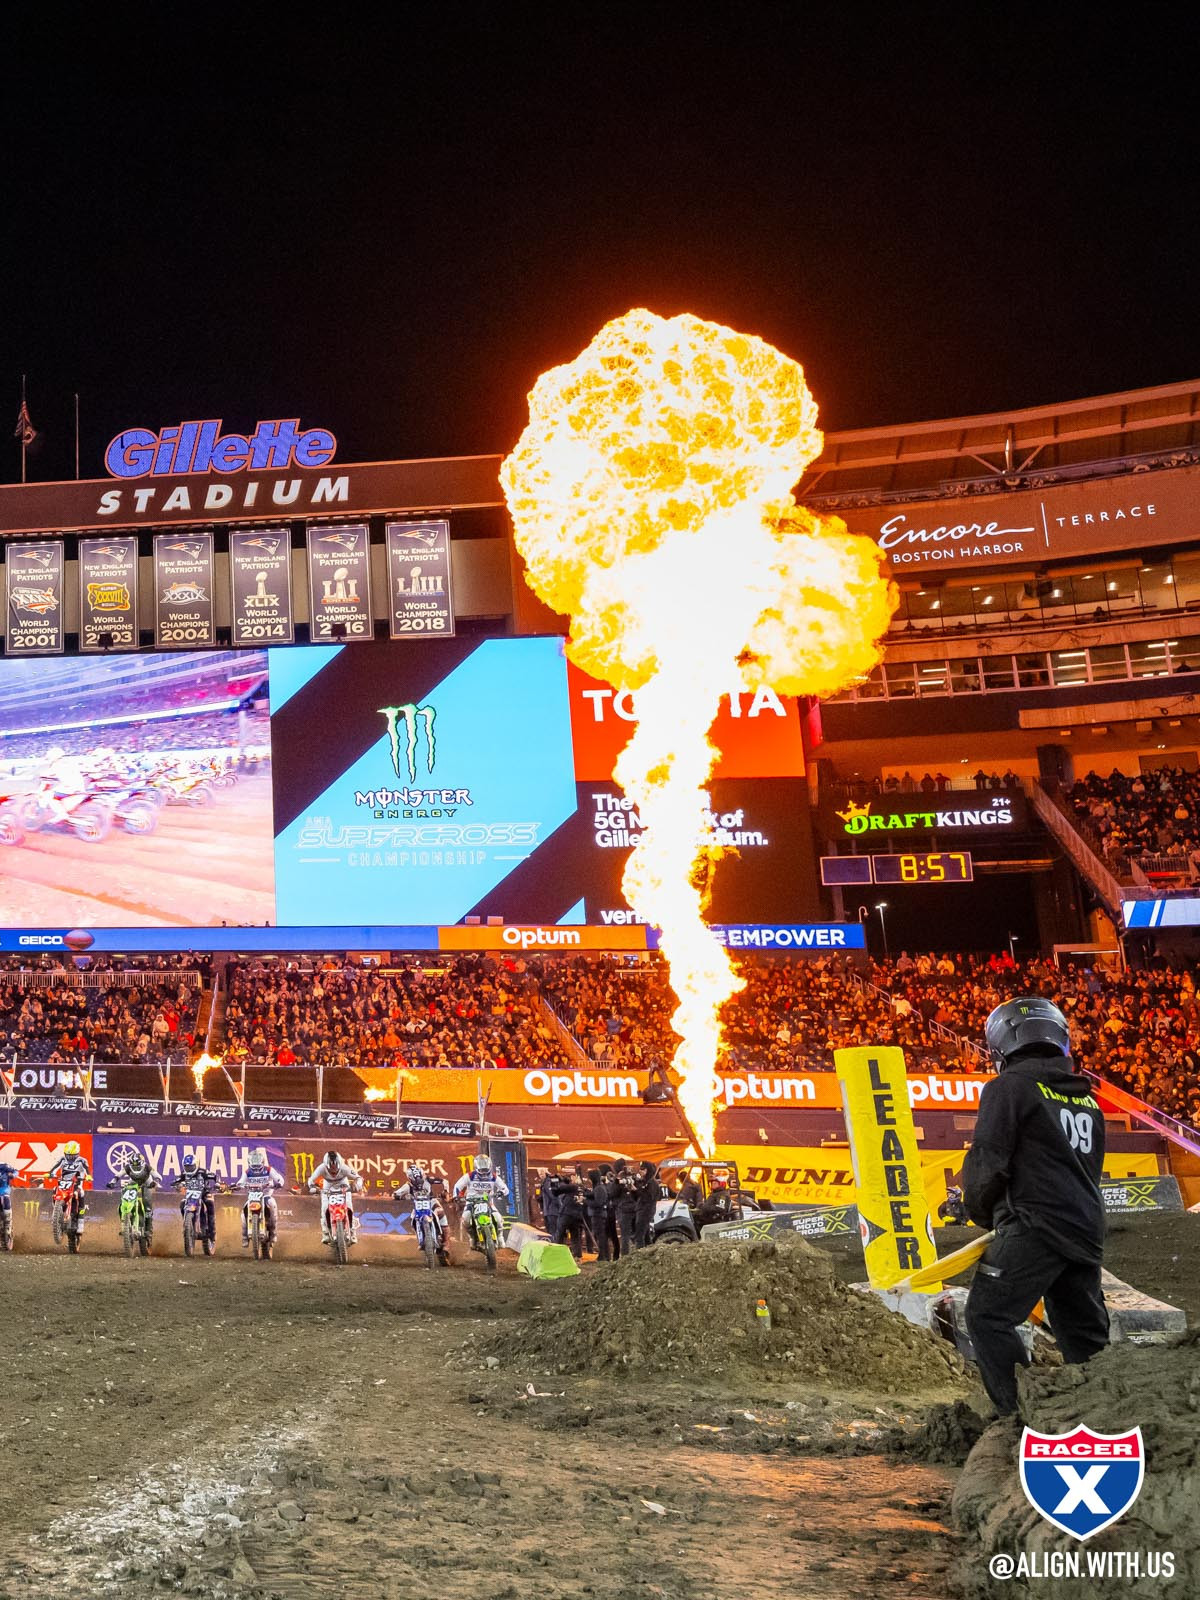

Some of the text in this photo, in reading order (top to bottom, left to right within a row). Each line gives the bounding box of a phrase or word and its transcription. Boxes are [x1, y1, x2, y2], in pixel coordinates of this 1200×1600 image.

[105, 418, 337, 480] Gillette
[96, 476, 350, 515] STADIUM
[877, 504, 1157, 549] Encore TERRACE
[313, 552, 329, 560] NEW
[398, 553, 439, 562] PATRIOTS
[892, 542, 1024, 564] BOSTON HARBOR
[159, 559, 209, 568] NEW ENGLAND
[241, 562, 280, 570] PATRIOTS
[319, 558, 359, 567] PATRIOTS
[11, 568, 27, 576] NEW
[89, 569, 128, 577] PATRIOTS
[164, 565, 204, 574] PATRIOTS
[16, 573, 53, 581] PATRIOTS
[244, 598, 280, 607] XLIX
[404, 602, 438, 610] WORLD
[246, 610, 278, 618] WORLD
[324, 606, 357, 614] WORLD
[395, 610, 448, 618] CHAMPIONS
[93, 616, 124, 624] WORLD
[169, 613, 200, 621] WORLD
[237, 617, 288, 626] CHAMPIONS
[315, 613, 367, 622] CHAMPIONS
[19, 619, 50, 627] WORLD
[84, 623, 134, 632] CHAMPIONS
[160, 620, 210, 629] CHAMPIONS
[400, 618, 445, 631] 2018
[10, 627, 59, 636] CHAMPIONS
[240, 625, 285, 638] 2014
[319, 622, 364, 635] 216
[86, 631, 133, 645] 203
[161, 629, 209, 641] 2004
[13, 634, 56, 647] 2001
[354, 786, 474, 808] MONSTER
[992, 797, 1011, 806] 21+
[592, 794, 634, 811] The
[373, 808, 458, 819] ENERGY
[594, 811, 626, 829] 5G
[719, 809, 744, 828] of
[844, 808, 1012, 835] DRAFTKINGS
[295, 821, 542, 849] SUPERCROSS
[348, 850, 487, 866] CHAMPIONSHIP
[899, 854, 967, 882] 8:57
[19, 935, 62, 945] GEICO
[503, 927, 580, 950] Optum
[728, 929, 846, 947] EMPOWER
[524, 1071, 638, 1103] Optum
[868, 1058, 923, 1270] LEADER
[122, 1189, 137, 1199] 43
[792, 1215, 825, 1226] SUPER
[796, 1222, 825, 1231] MOTO
